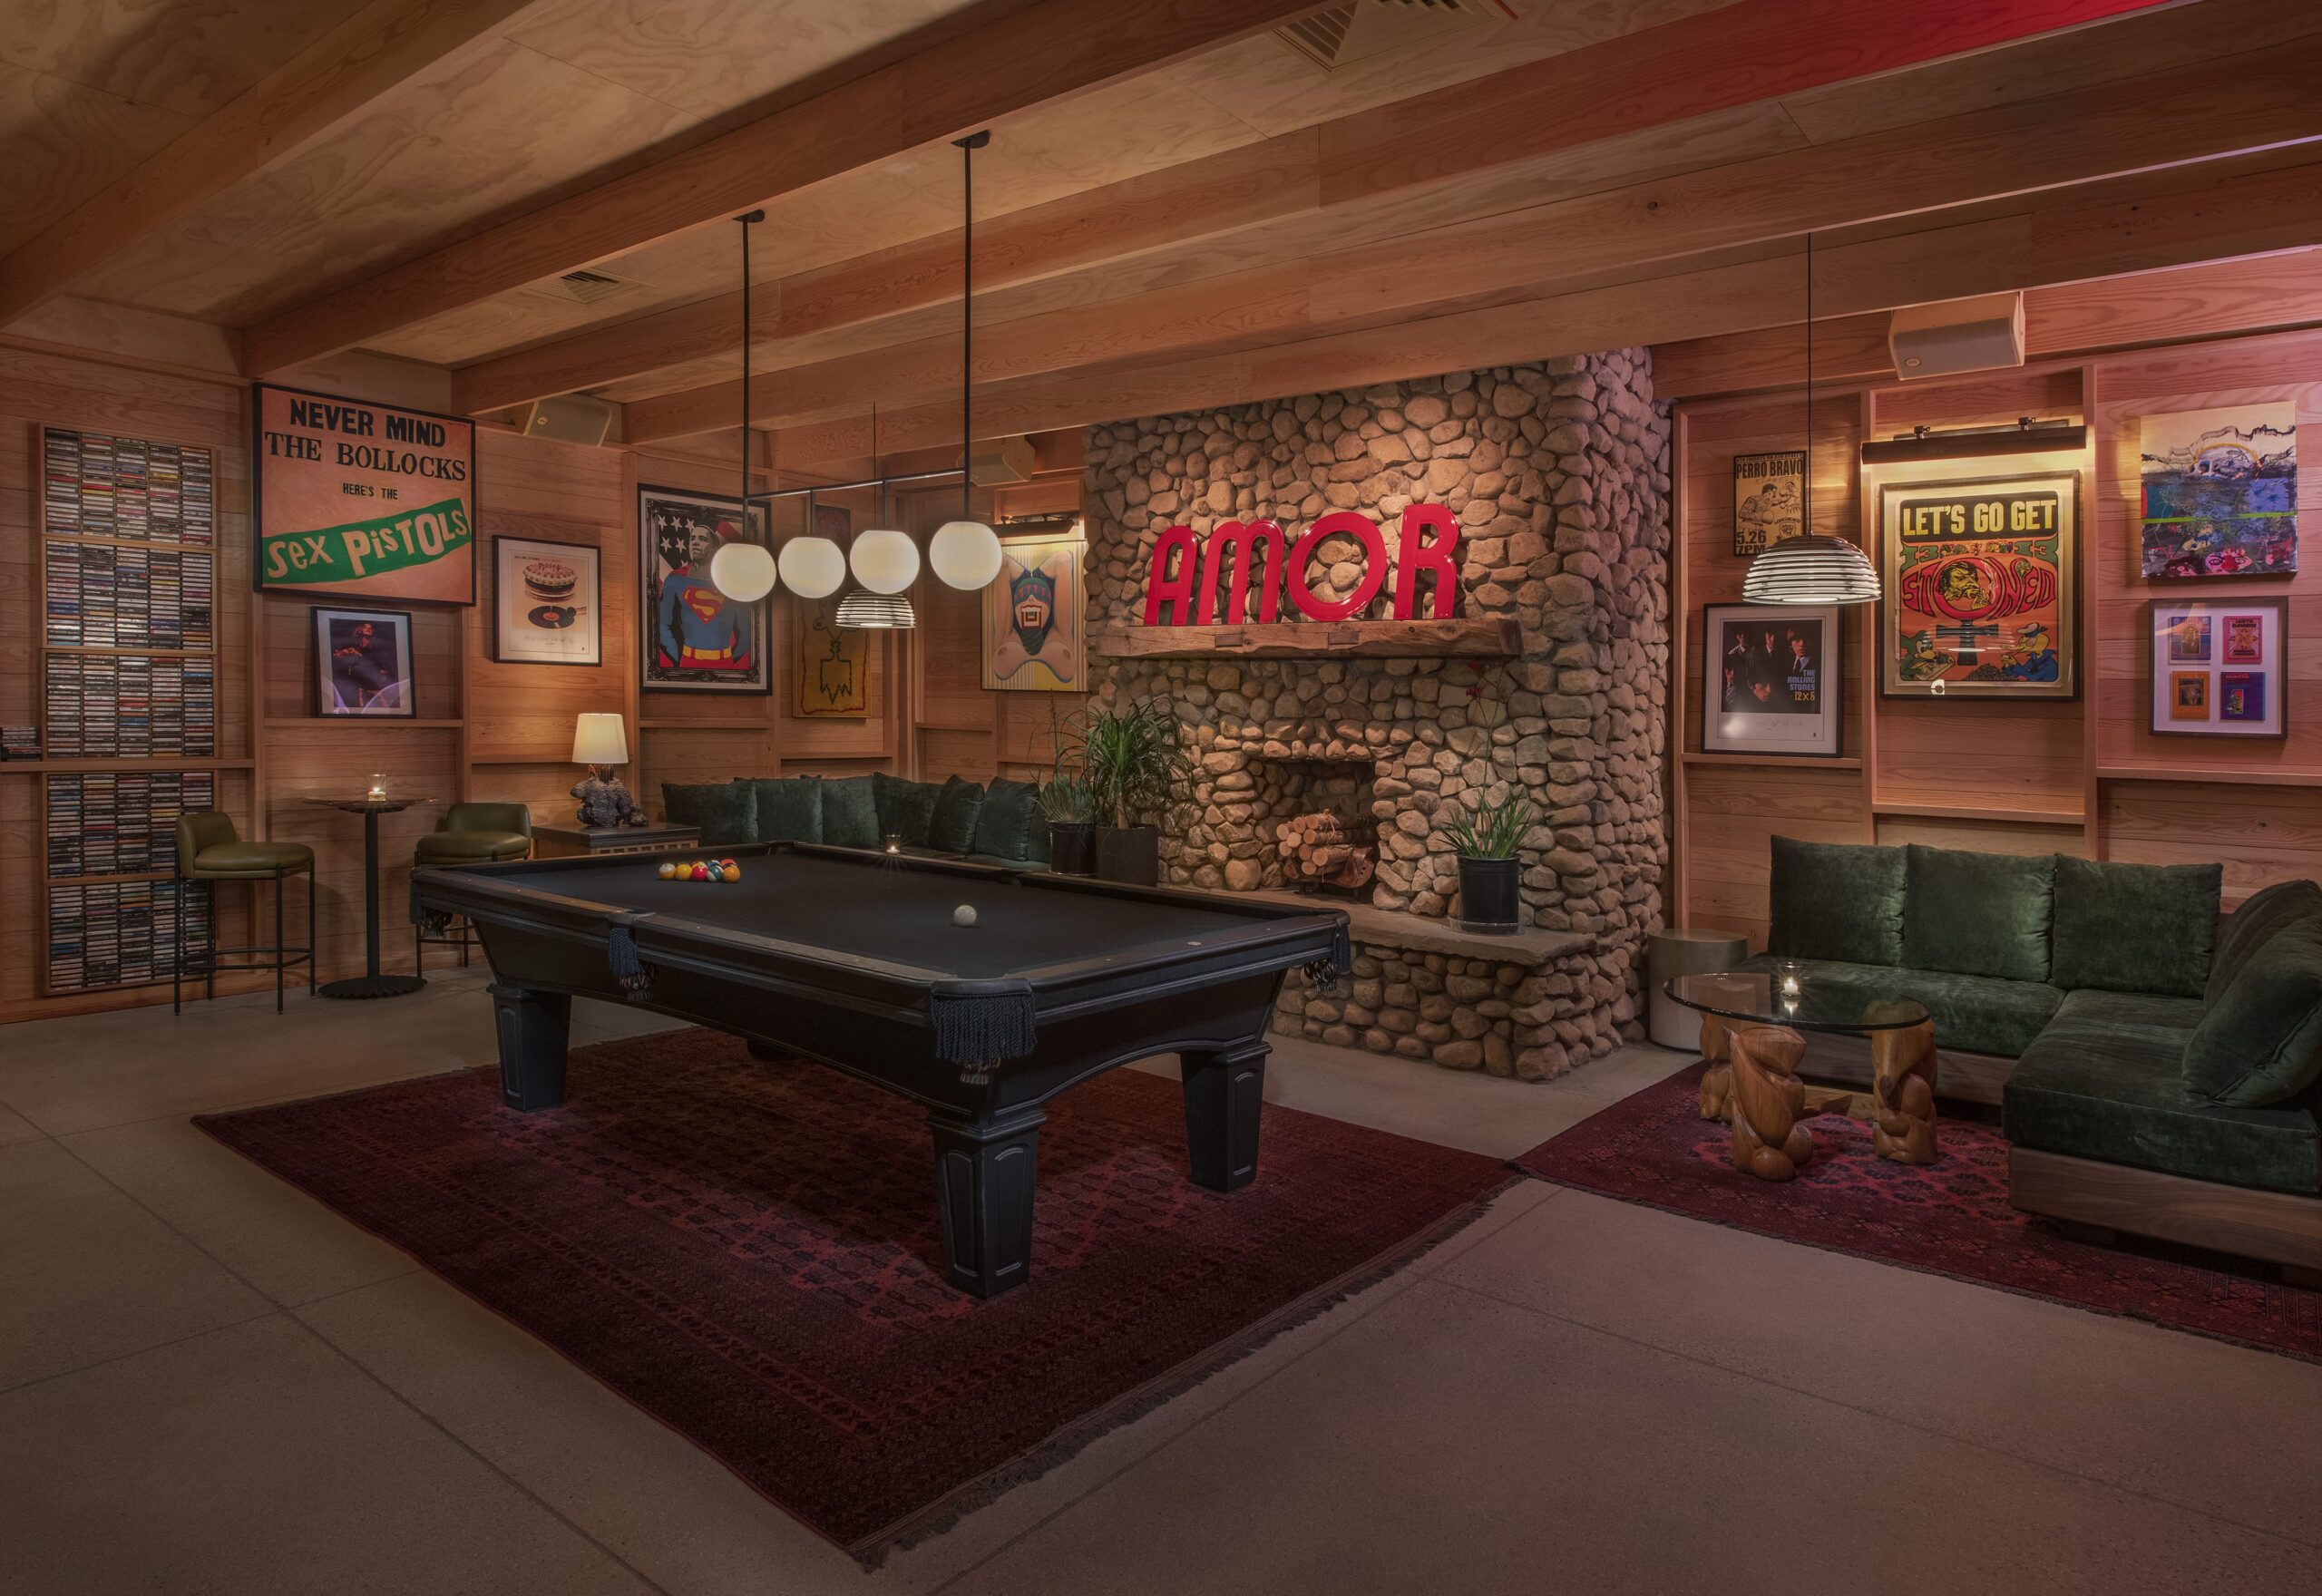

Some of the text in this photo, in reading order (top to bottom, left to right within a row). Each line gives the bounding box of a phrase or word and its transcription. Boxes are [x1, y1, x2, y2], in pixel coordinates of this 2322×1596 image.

[289, 398, 445, 448] NEVER MIND
[265, 431, 466, 482] THE BOLLOCKS
[1736, 459, 1803, 479] PERRO BRAVO
[342, 482, 398, 500] HERE'S THE
[1736, 530, 1767, 544] 5.26
[1903, 499, 2057, 536] LET'S GO GET
[1144, 503, 1459, 626] AMOR
[1902, 556, 2056, 621] STONED
